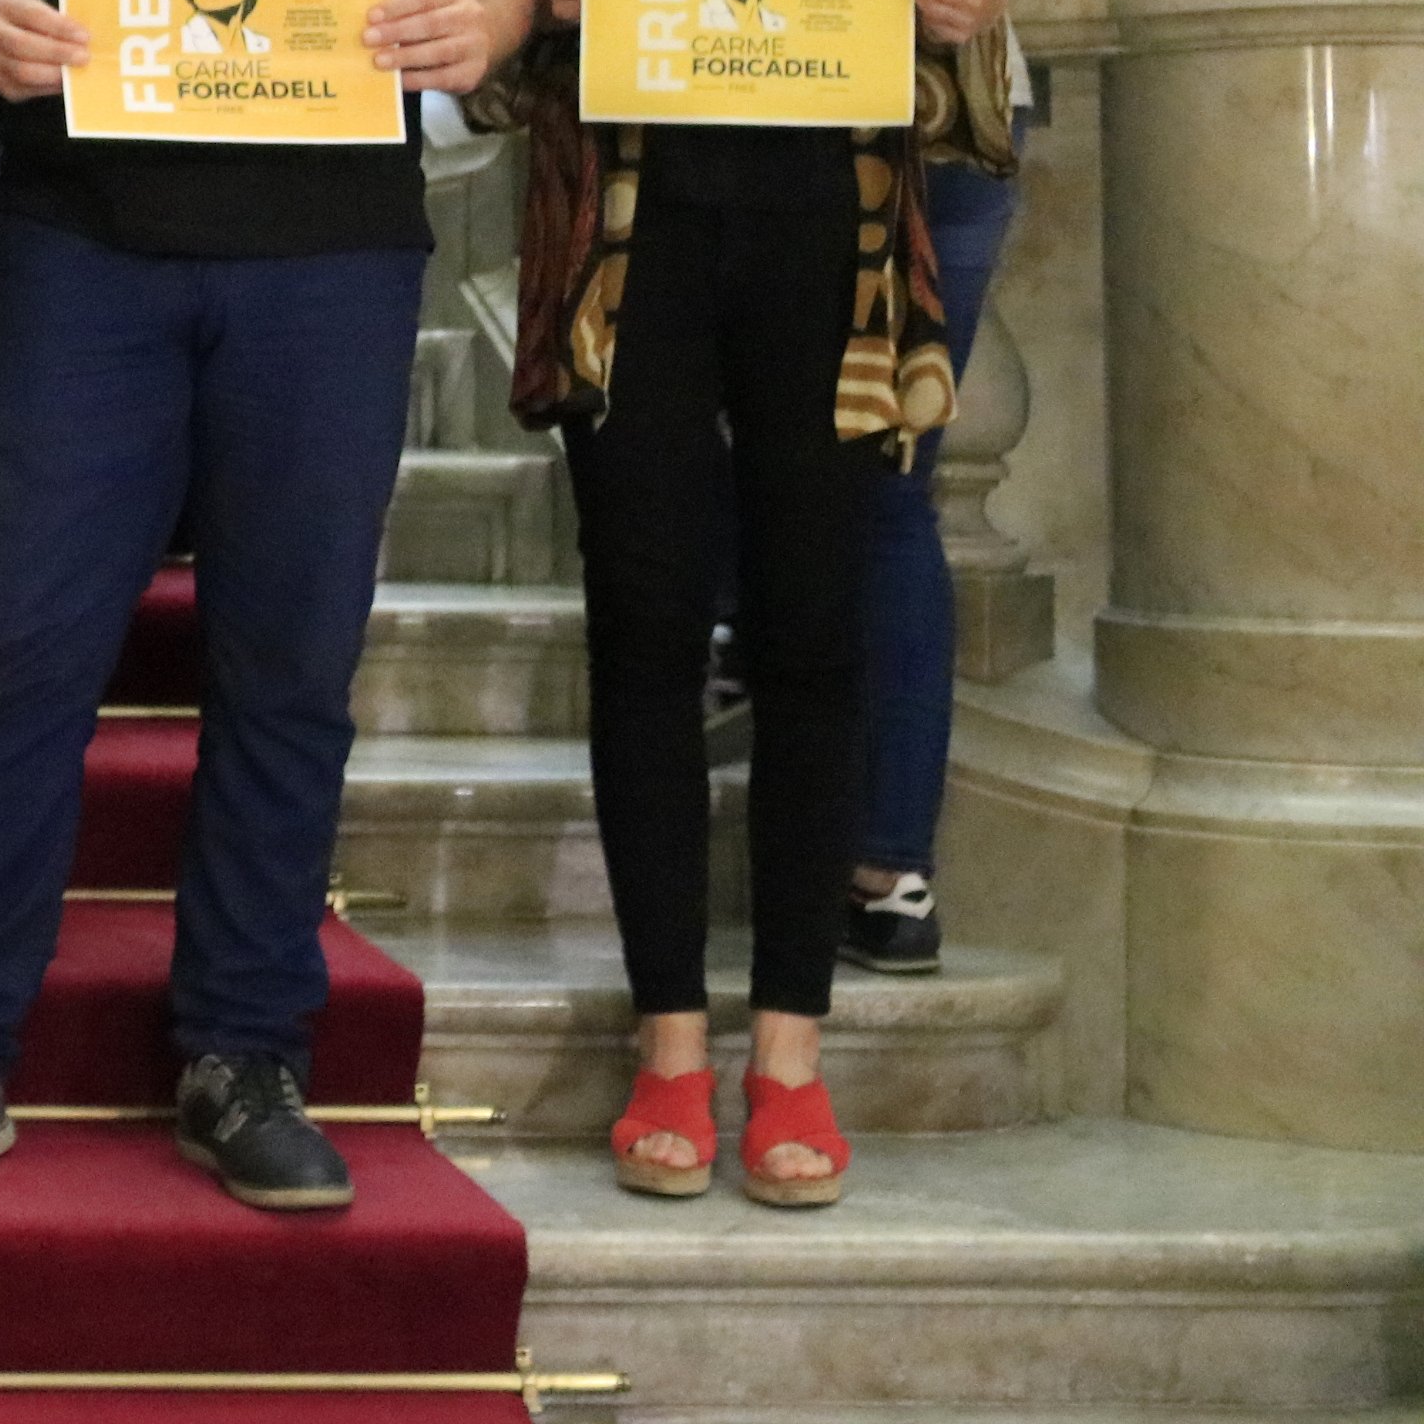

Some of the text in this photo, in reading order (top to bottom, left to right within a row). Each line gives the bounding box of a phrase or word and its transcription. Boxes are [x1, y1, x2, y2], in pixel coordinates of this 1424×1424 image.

[691, 34, 786, 57] CARME
[175, 58, 272, 80] CARME
[692, 57, 851, 79] FORCADELL
[178, 79, 337, 100] FORCADELL
